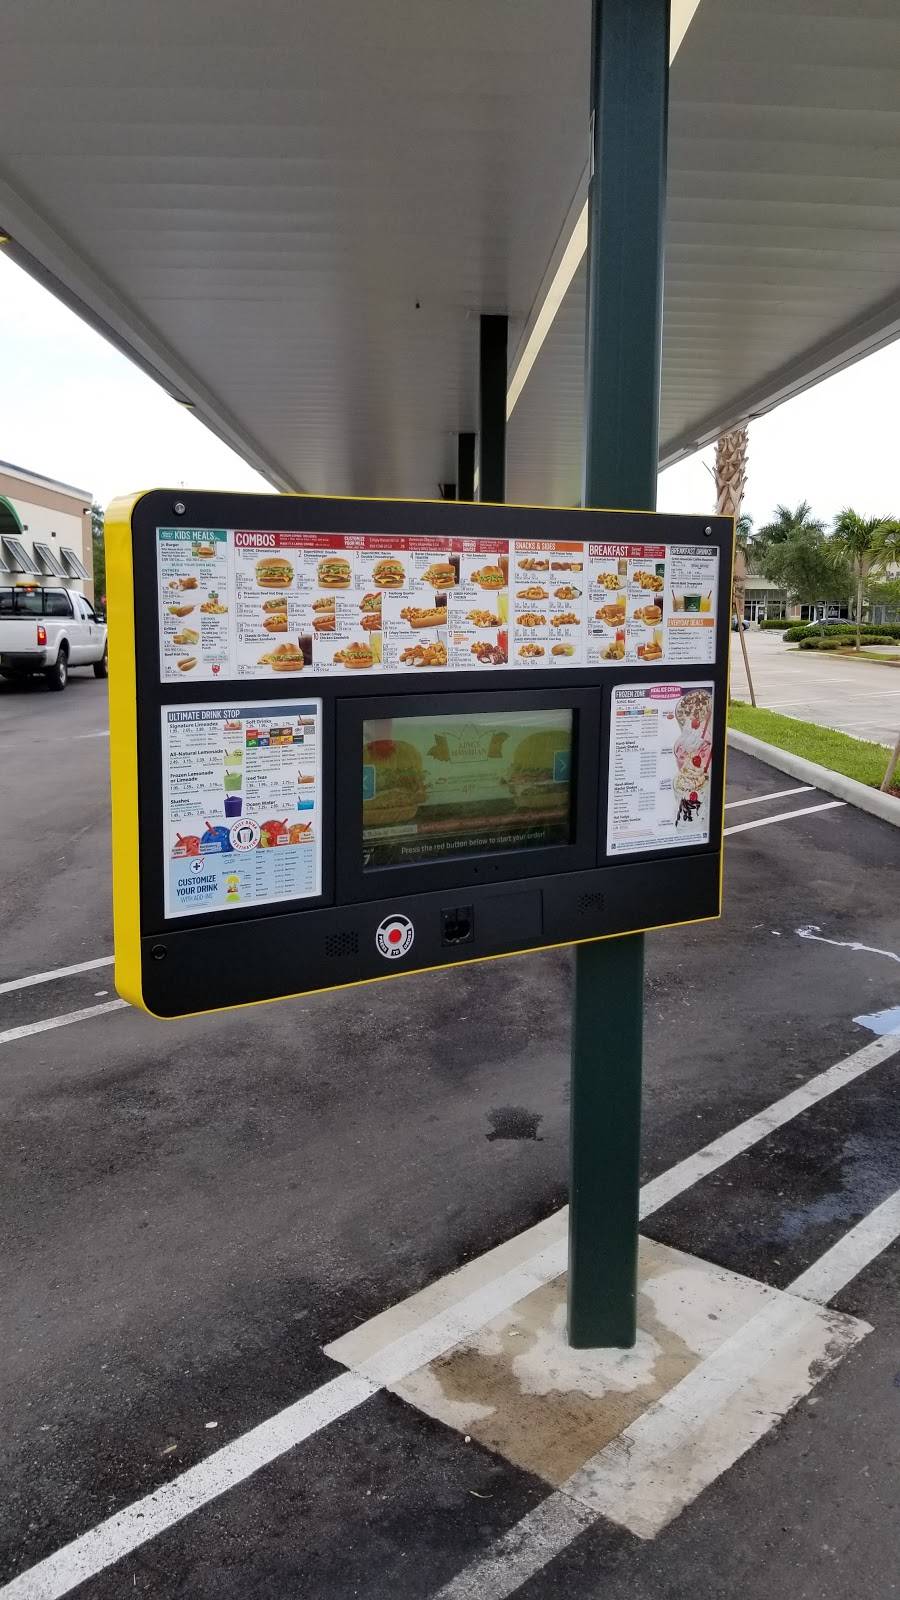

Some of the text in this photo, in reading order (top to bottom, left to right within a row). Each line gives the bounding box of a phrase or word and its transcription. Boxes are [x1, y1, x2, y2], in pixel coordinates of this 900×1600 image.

[174, 530, 190, 540] KIDS
[192, 530, 214, 540] MEALS
[236, 533, 276, 547] COMBOS
[516, 542, 536, 550] SNACKS
[589, 545, 628, 557] BREAKFAST
[410, 552, 414, 560] 4
[616, 690, 645, 698] FROZEN ZONE
[168, 710, 240, 721] ULTIMATE DRINK STOP
[402, 846, 420, 854] Press
[512, 834, 526, 842] your
[178, 874, 216, 887] CUSTOMIZE
[176, 884, 218, 896] YOUR DRINK
